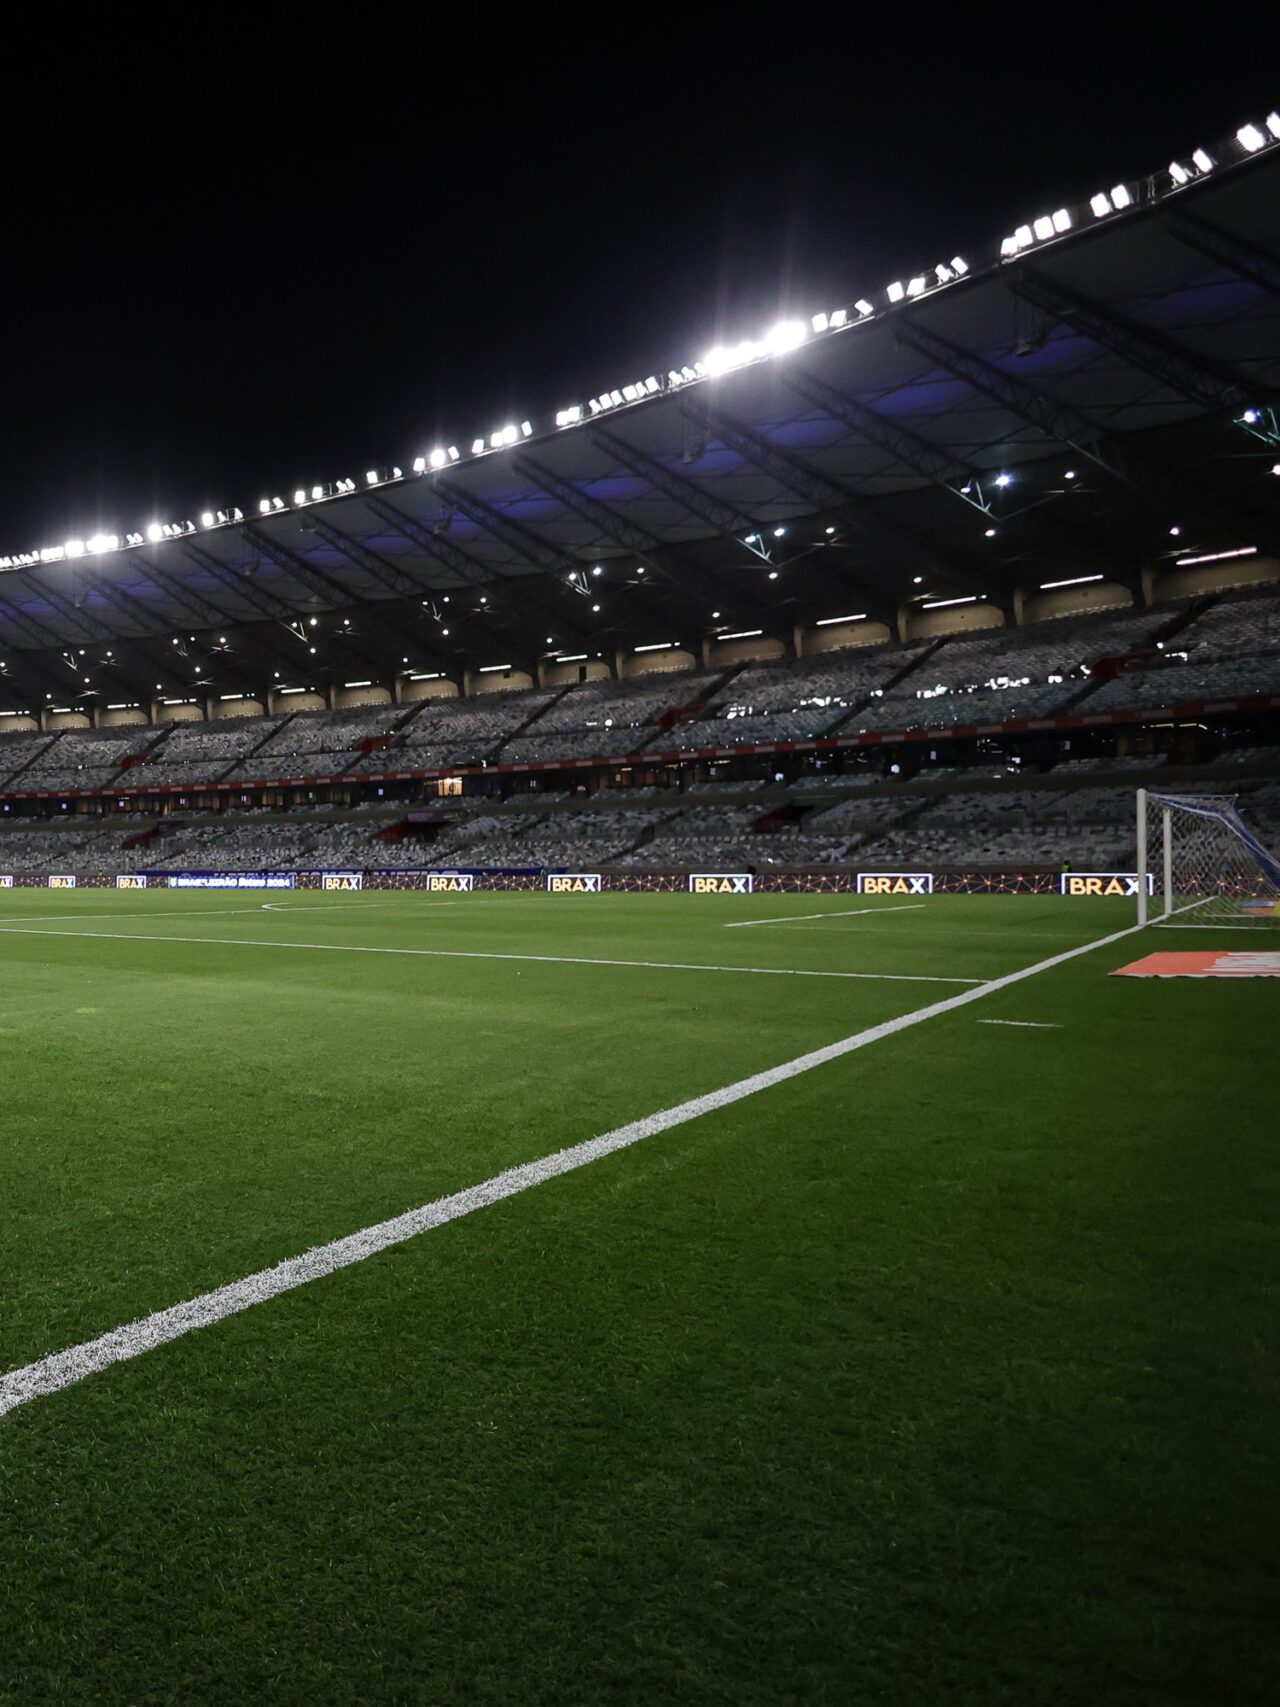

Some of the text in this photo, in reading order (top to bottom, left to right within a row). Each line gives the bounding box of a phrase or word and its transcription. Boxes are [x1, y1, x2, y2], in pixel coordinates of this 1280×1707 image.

[51, 878, 74, 888] BRAX
[120, 878, 143, 889] BRAX
[325, 878, 358, 890] BRAX
[431, 878, 469, 891] BRAX
[552, 878, 596, 892] BRAX
[695, 877, 746, 893] BRAX
[864, 877, 925, 894] BRAX
[1070, 878, 1138, 895] BRAX
